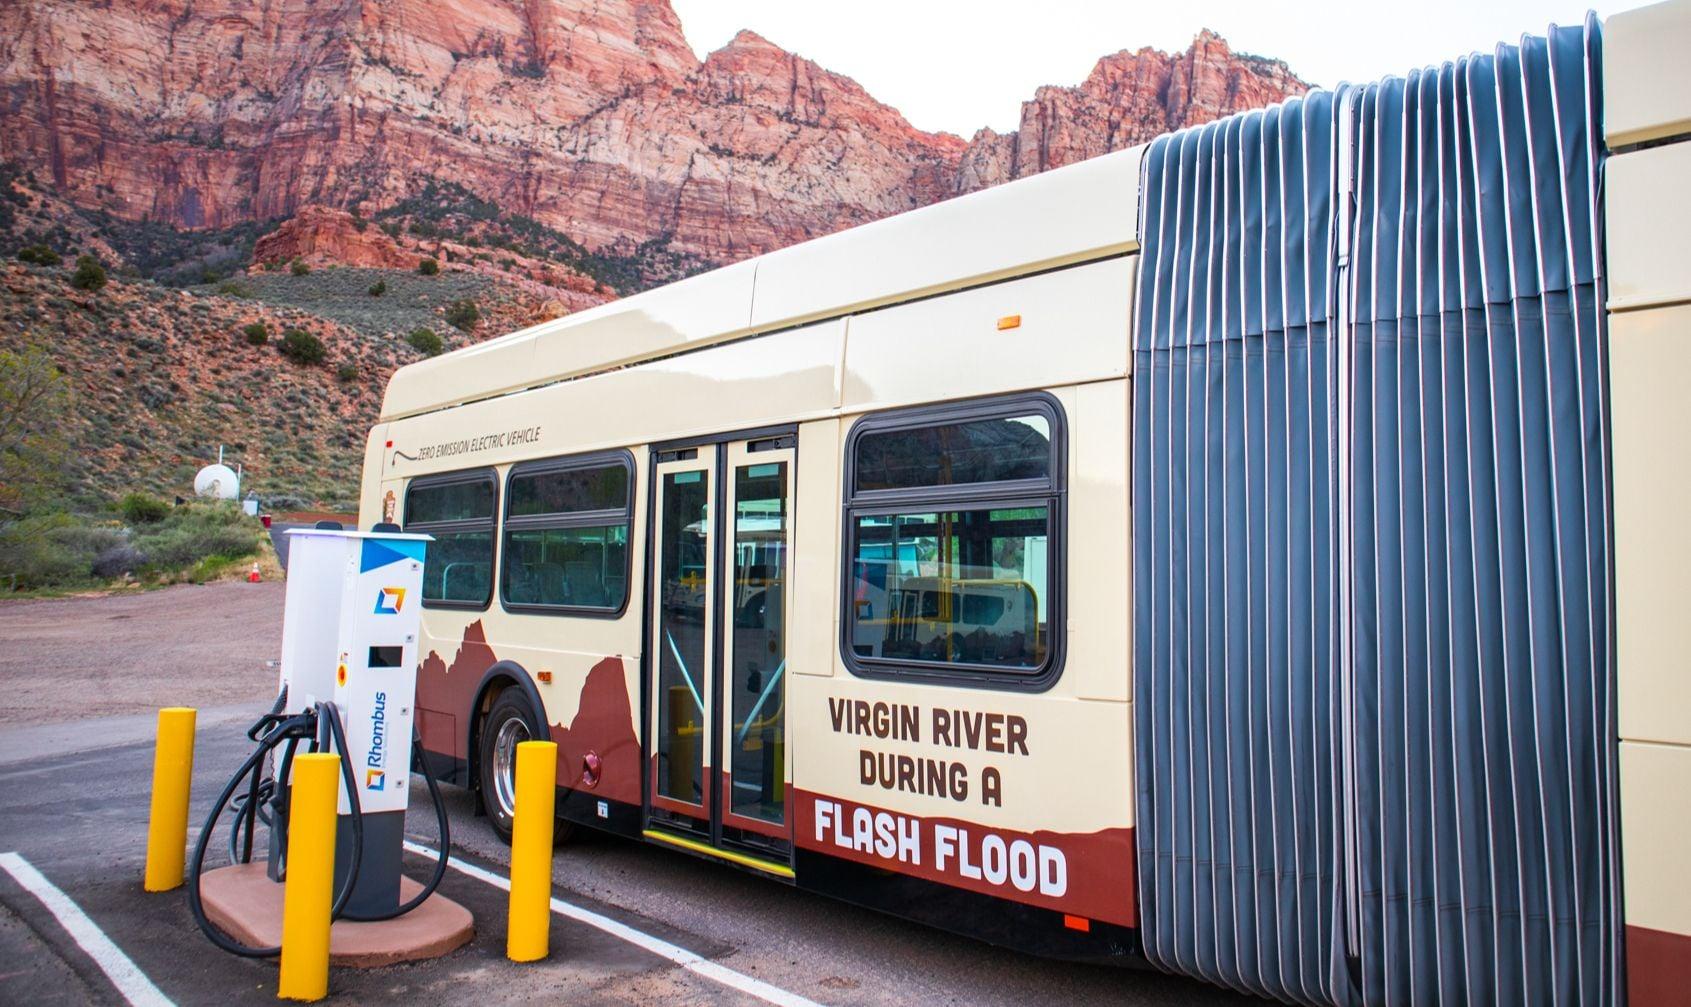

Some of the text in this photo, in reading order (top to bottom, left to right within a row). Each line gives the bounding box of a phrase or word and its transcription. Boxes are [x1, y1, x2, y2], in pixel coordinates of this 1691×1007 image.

[417, 427, 541, 461] ZERO EMISSION ELECTRIC VEHICLE
[368, 692, 386, 767] Rhombus
[828, 697, 1029, 756] VIRGIN RIVER
[859, 750, 1002, 807] DURING A
[815, 799, 1067, 897] FLASH FLOOD
